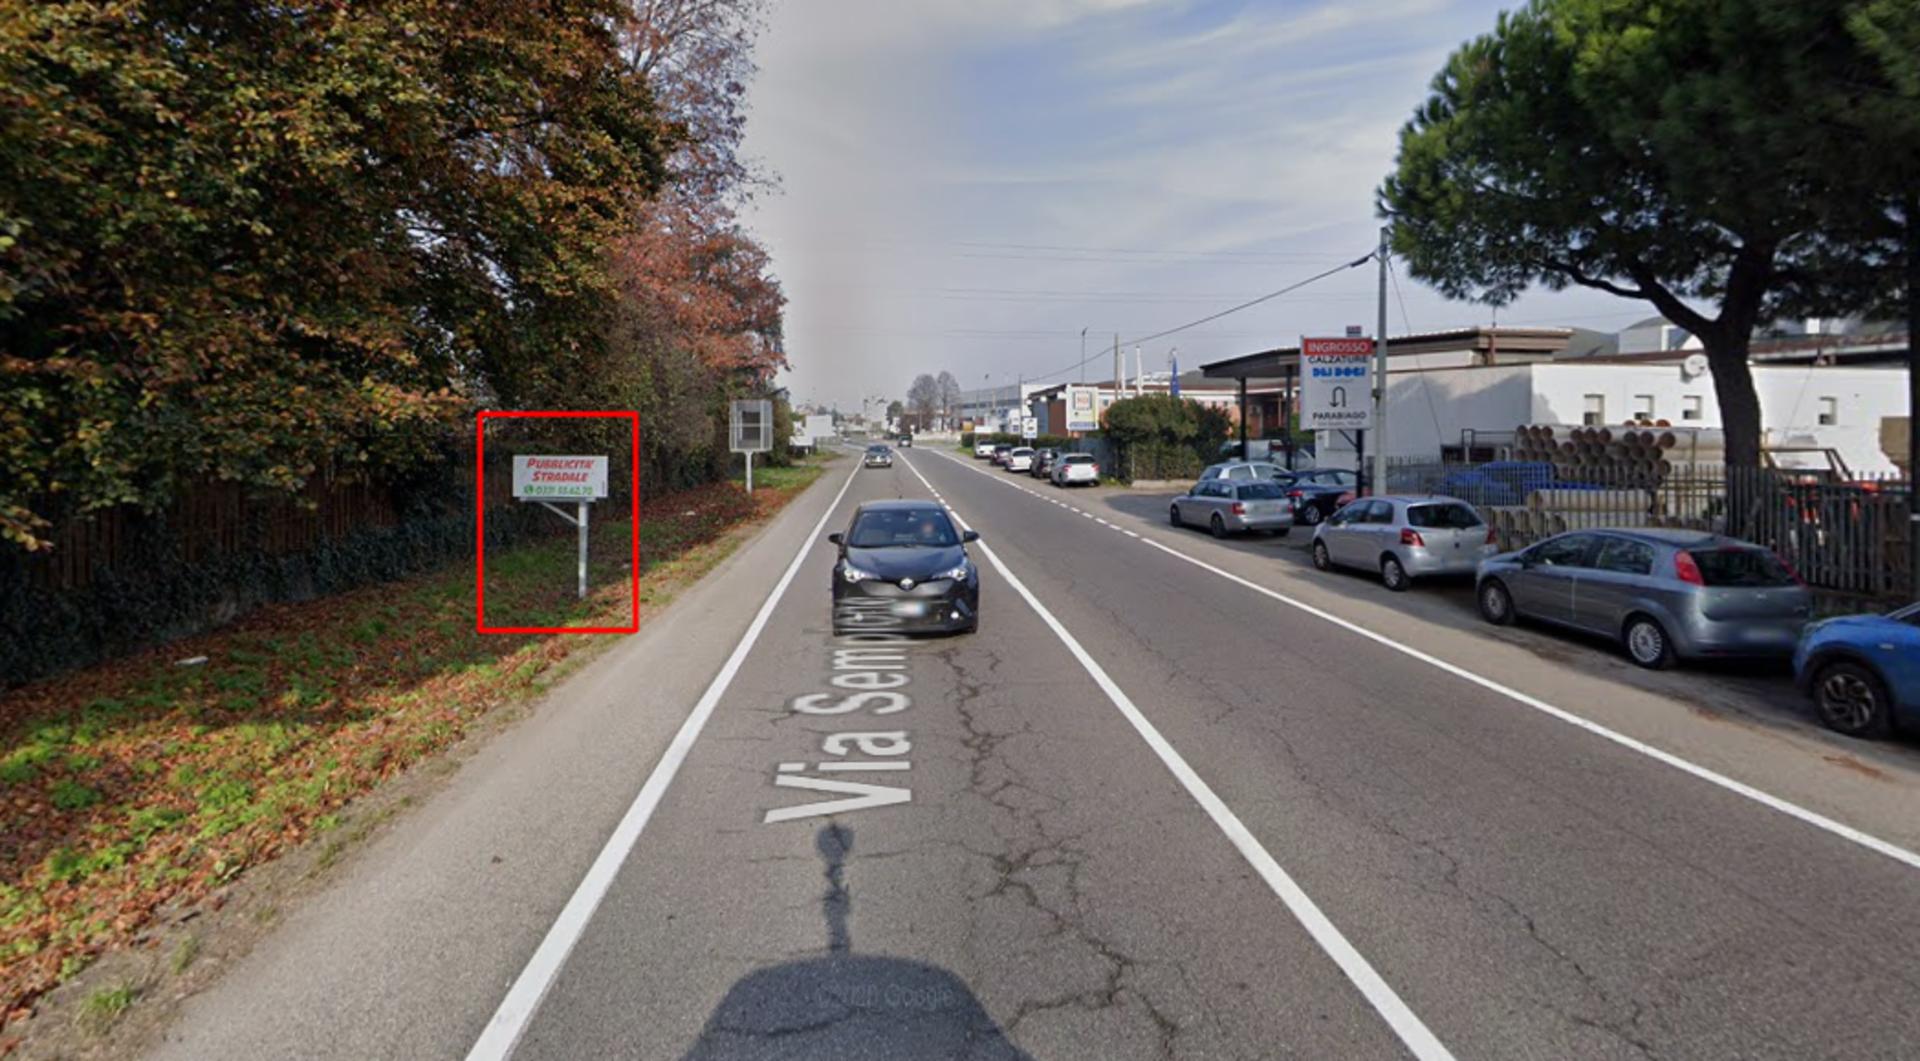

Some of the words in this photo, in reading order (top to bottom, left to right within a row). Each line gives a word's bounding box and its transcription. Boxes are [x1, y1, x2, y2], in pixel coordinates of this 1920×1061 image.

[1308, 342, 1369, 353] INGROSSO
[1312, 412, 1367, 420] PARABIAGO
[532, 471, 589, 482] STRADALE
